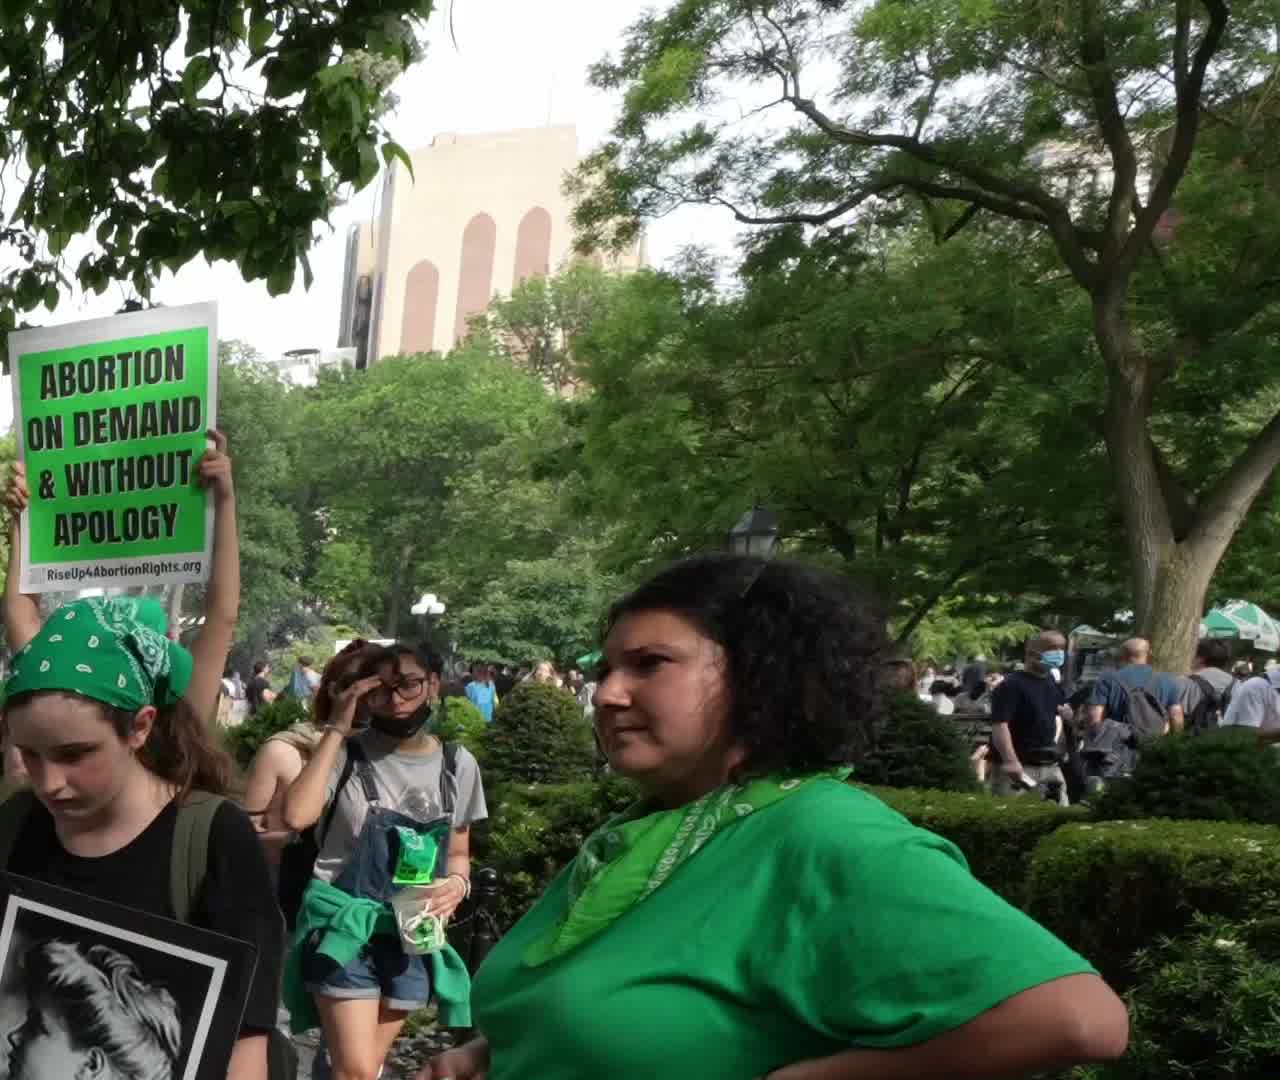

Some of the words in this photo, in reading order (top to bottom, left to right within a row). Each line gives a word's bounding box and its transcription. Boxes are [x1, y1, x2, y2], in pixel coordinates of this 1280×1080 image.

[40, 344, 185, 400] ABORTION
[27, 415, 63, 451] ON
[72, 395, 201, 446] DEMAND
[39, 469, 56, 500] &
[64, 449, 192, 498] WITHOUT
[54, 503, 178, 547] APOLOGY
[47, 561, 202, 581] RiseUp4AbortionRights.org
